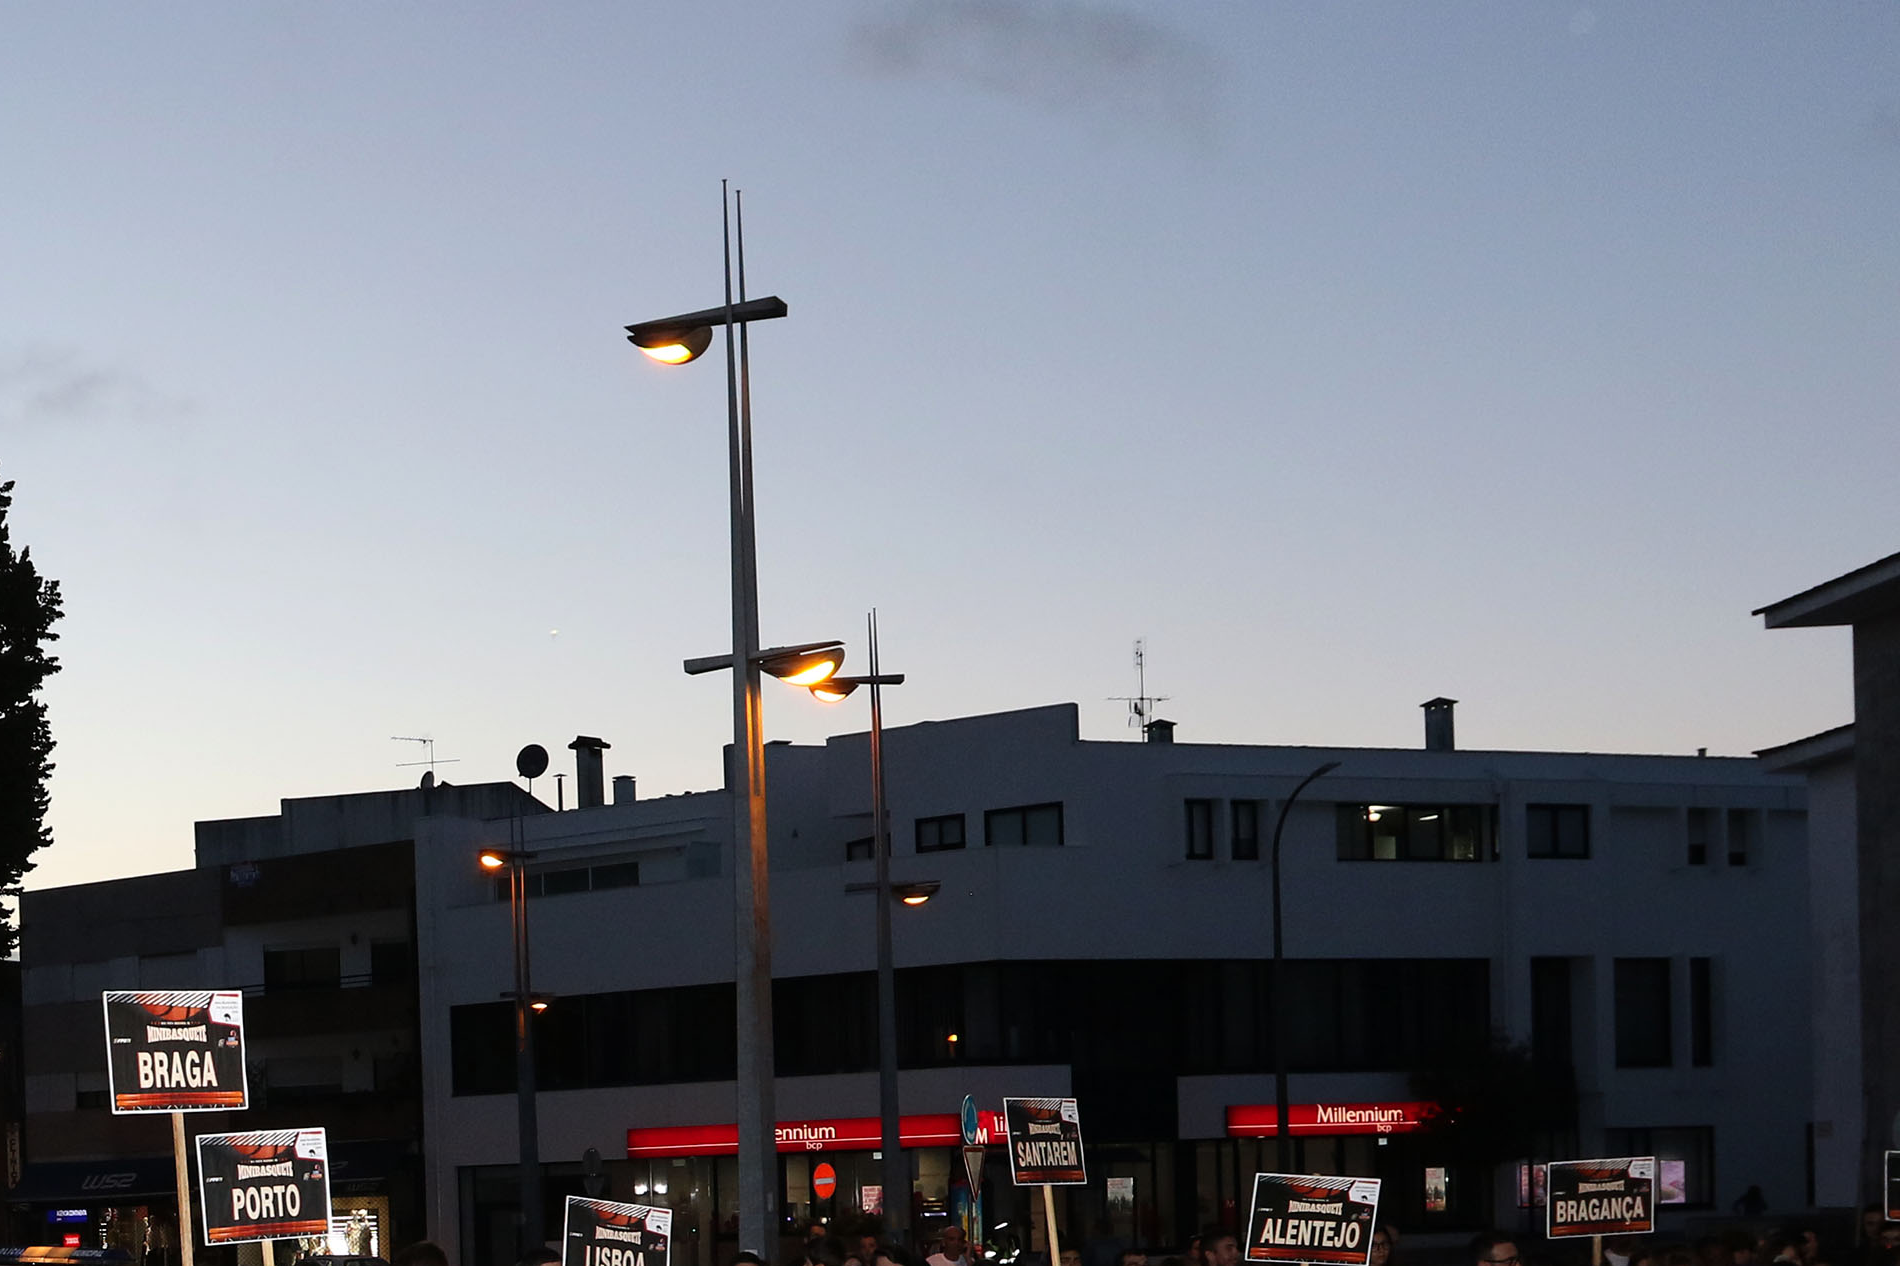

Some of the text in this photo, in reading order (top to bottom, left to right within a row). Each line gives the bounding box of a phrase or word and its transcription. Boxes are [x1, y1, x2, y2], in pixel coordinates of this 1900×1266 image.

[137, 1050, 218, 1088] BRAGA
[1317, 1103, 1403, 1123] Millennium
[775, 1124, 836, 1140] ennium
[1377, 1123, 1392, 1133] bcp
[805, 1141, 823, 1151] bcp
[231, 1184, 301, 1220] PORTO
[1556, 1196, 1644, 1225] BRAGANÇA
[1260, 1218, 1360, 1248] ALENTEJO
